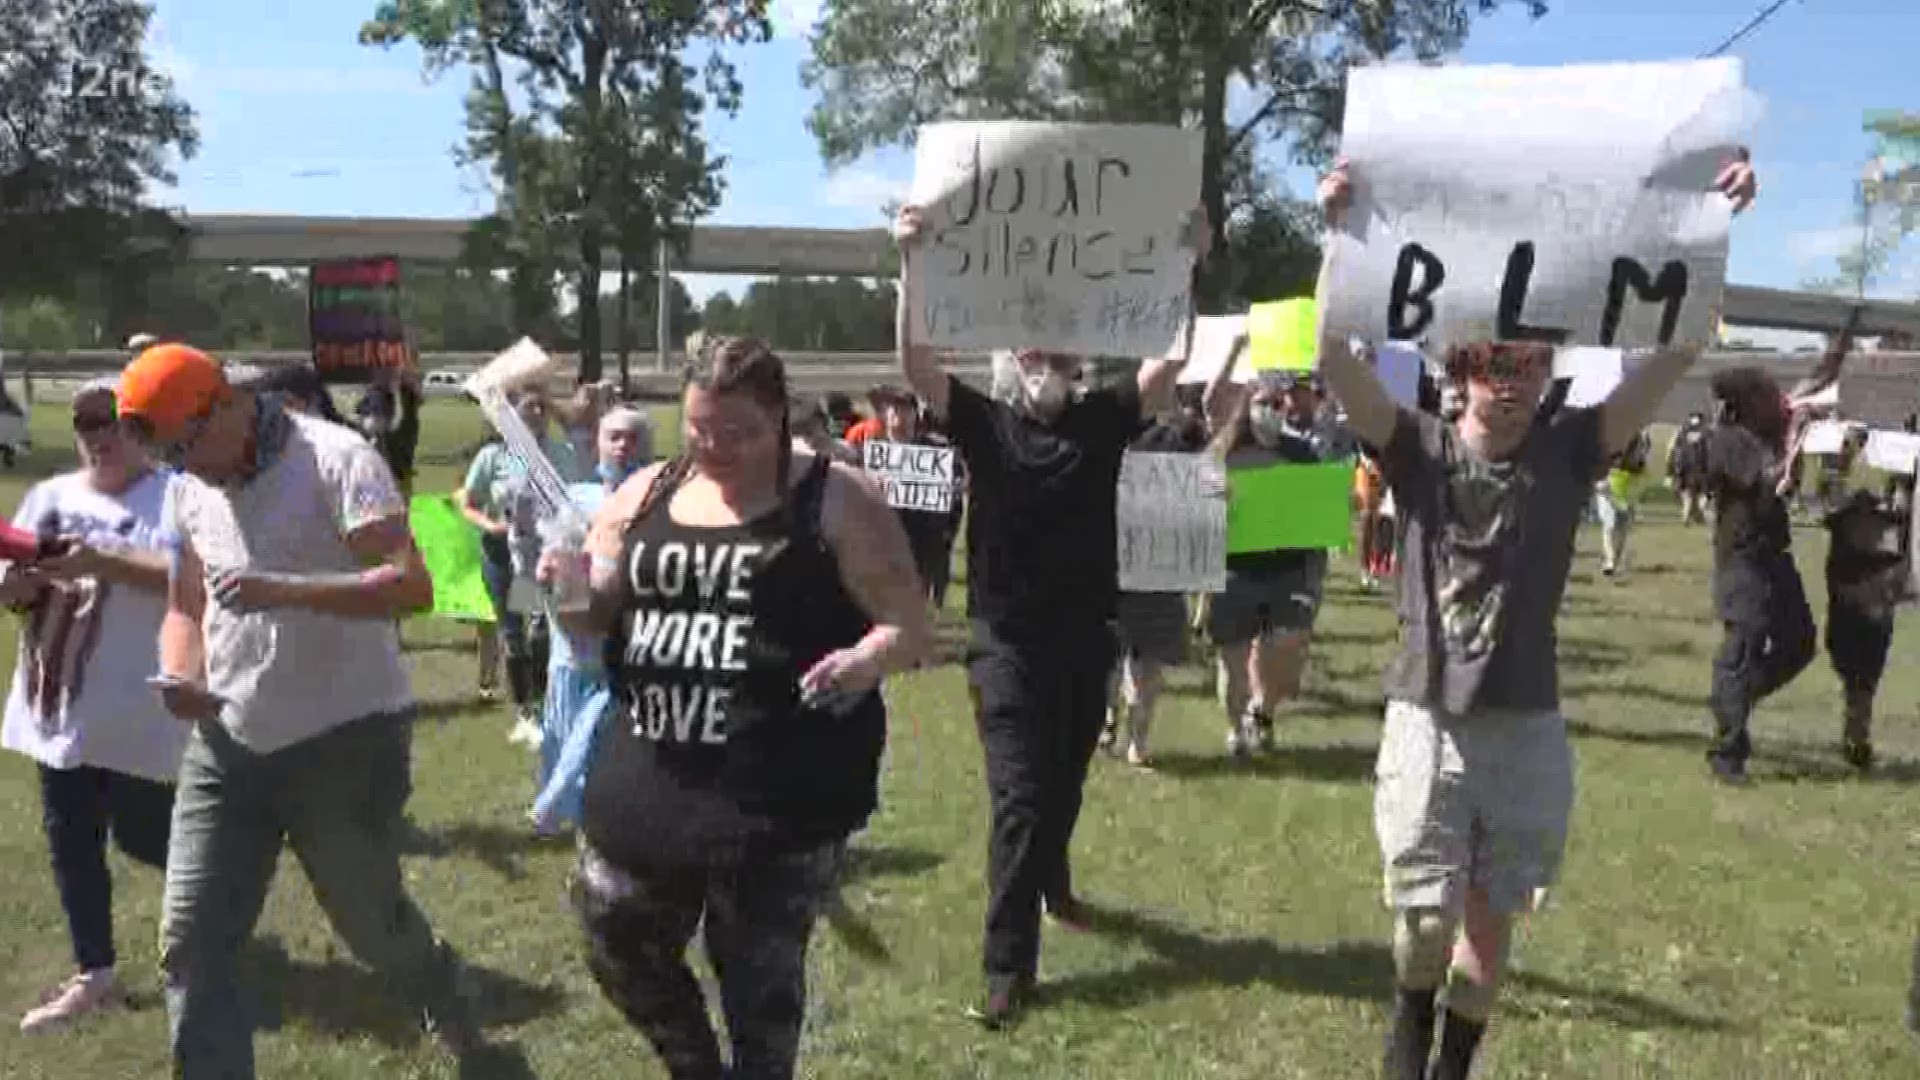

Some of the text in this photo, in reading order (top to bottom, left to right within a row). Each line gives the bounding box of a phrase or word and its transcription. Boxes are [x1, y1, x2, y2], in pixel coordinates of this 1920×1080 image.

[868, 443, 949, 478] BLACK
[880, 478, 949, 508] ATTER
[629, 540, 763, 600] LOVE
[624, 609, 756, 671] MORE
[628, 681, 732, 744] LOVE
